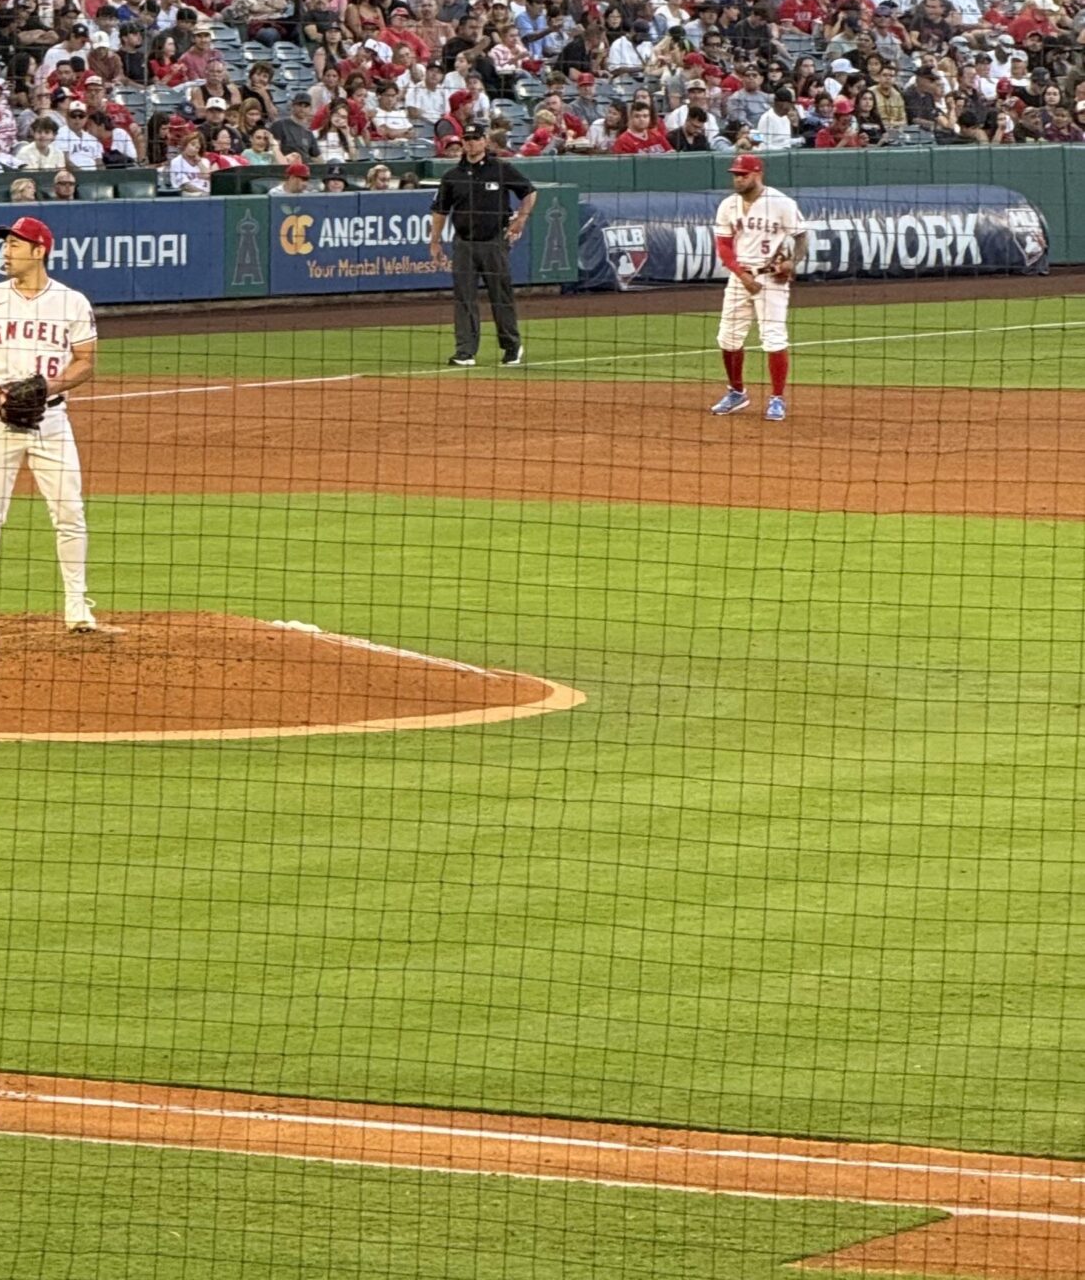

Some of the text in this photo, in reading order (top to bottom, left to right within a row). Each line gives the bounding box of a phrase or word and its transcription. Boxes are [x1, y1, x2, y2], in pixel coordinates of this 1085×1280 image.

[47, 233, 188, 271] HYUNDAI
[760, 239, 771, 255] 5
[306, 259, 335, 279] Your
[337, 257, 380, 277] Mental
[381, 254, 437, 275] Wellness
[35, 354, 61, 380] 16
